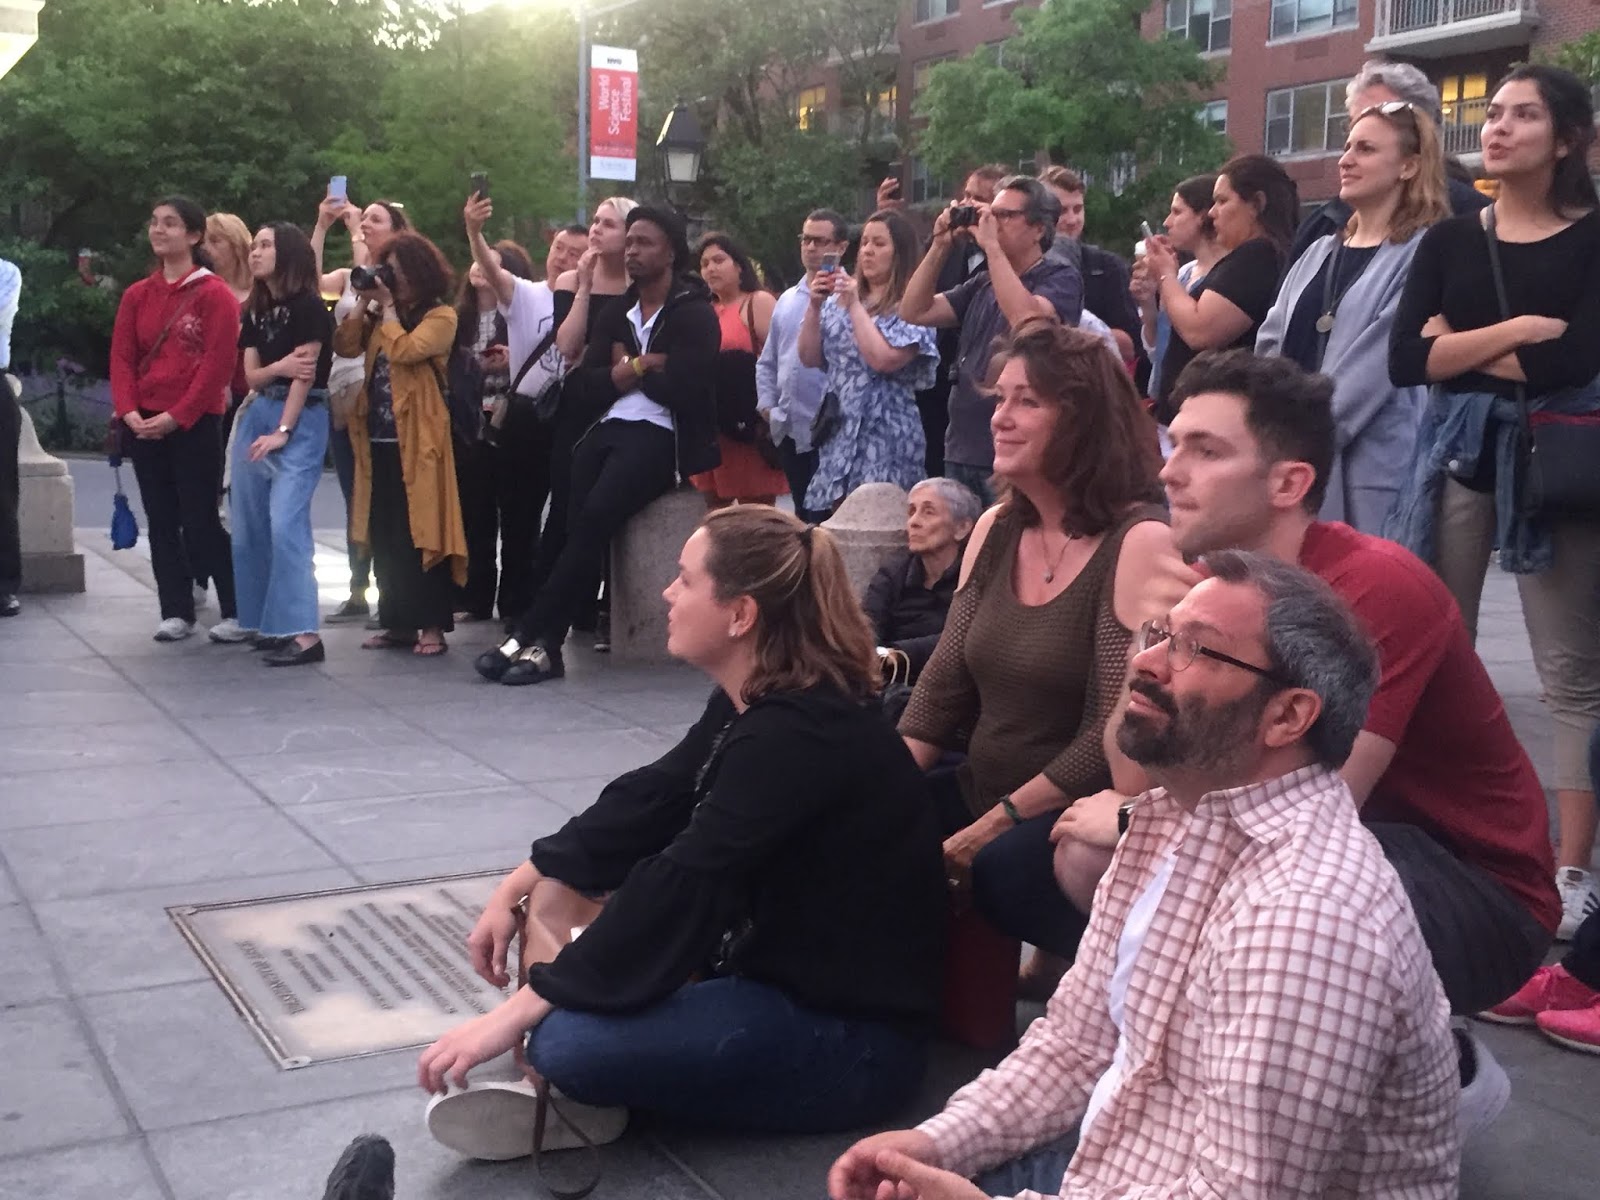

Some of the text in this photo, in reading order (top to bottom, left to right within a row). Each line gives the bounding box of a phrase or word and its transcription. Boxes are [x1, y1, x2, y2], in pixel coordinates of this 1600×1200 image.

[598, 75, 610, 110] World
[608, 89, 620, 135] Science
[620, 77, 632, 121] Festival
